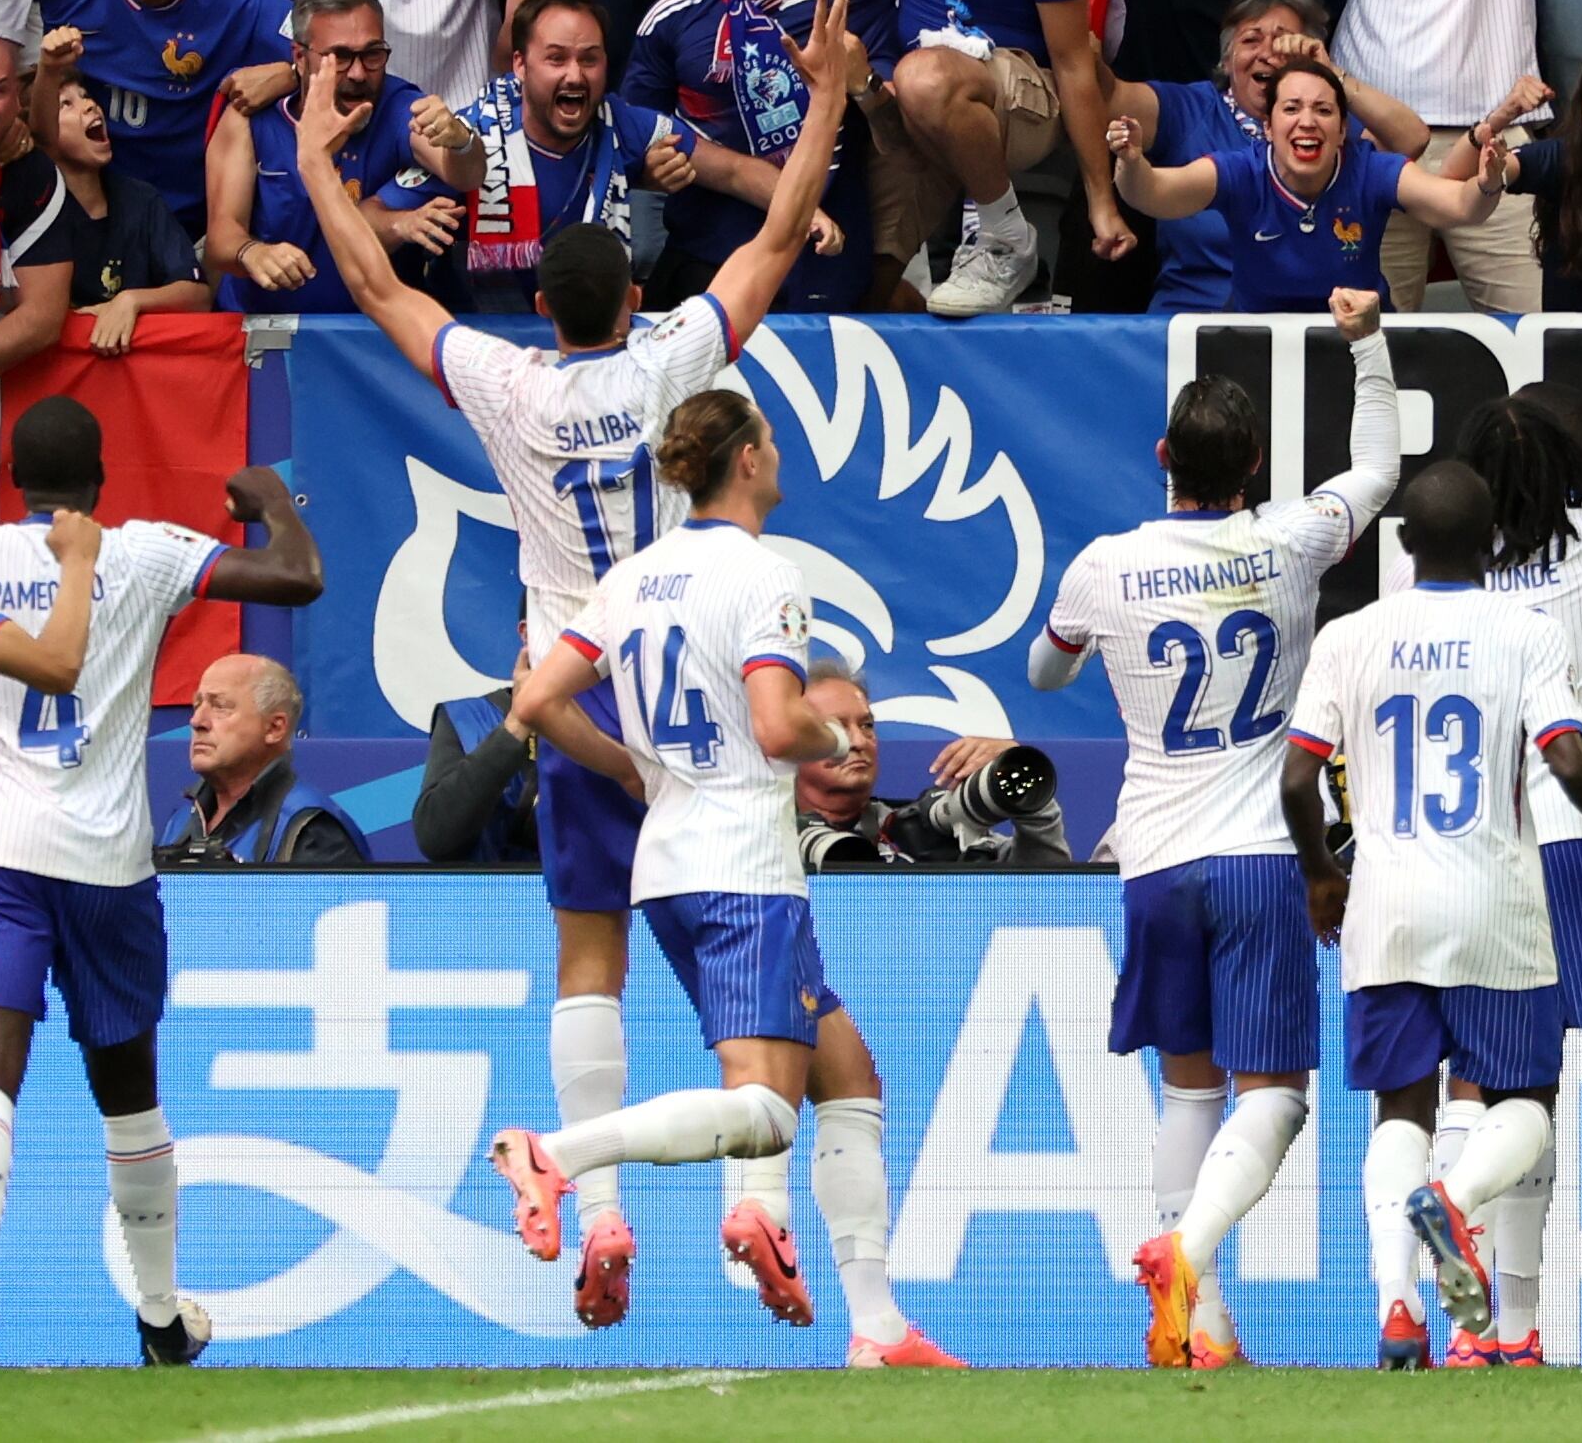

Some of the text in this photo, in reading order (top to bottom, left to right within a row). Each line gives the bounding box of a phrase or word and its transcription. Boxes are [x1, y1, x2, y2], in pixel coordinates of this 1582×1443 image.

[764, 53, 804, 92] FRANCE
[108, 87, 149, 128] 10
[758, 119, 806, 152] 200
[555, 411, 642, 452] SALIBA
[553, 442, 656, 584] 17
[1119, 550, 1282, 604] T.HERNANDEZ
[1482, 561, 1562, 593] OUNDE
[1389, 640, 1471, 671] KANTE
[620, 624, 724, 769] 14
[1146, 608, 1287, 758] 22
[19, 684, 91, 769] 4
[1374, 693, 1485, 840] 13
